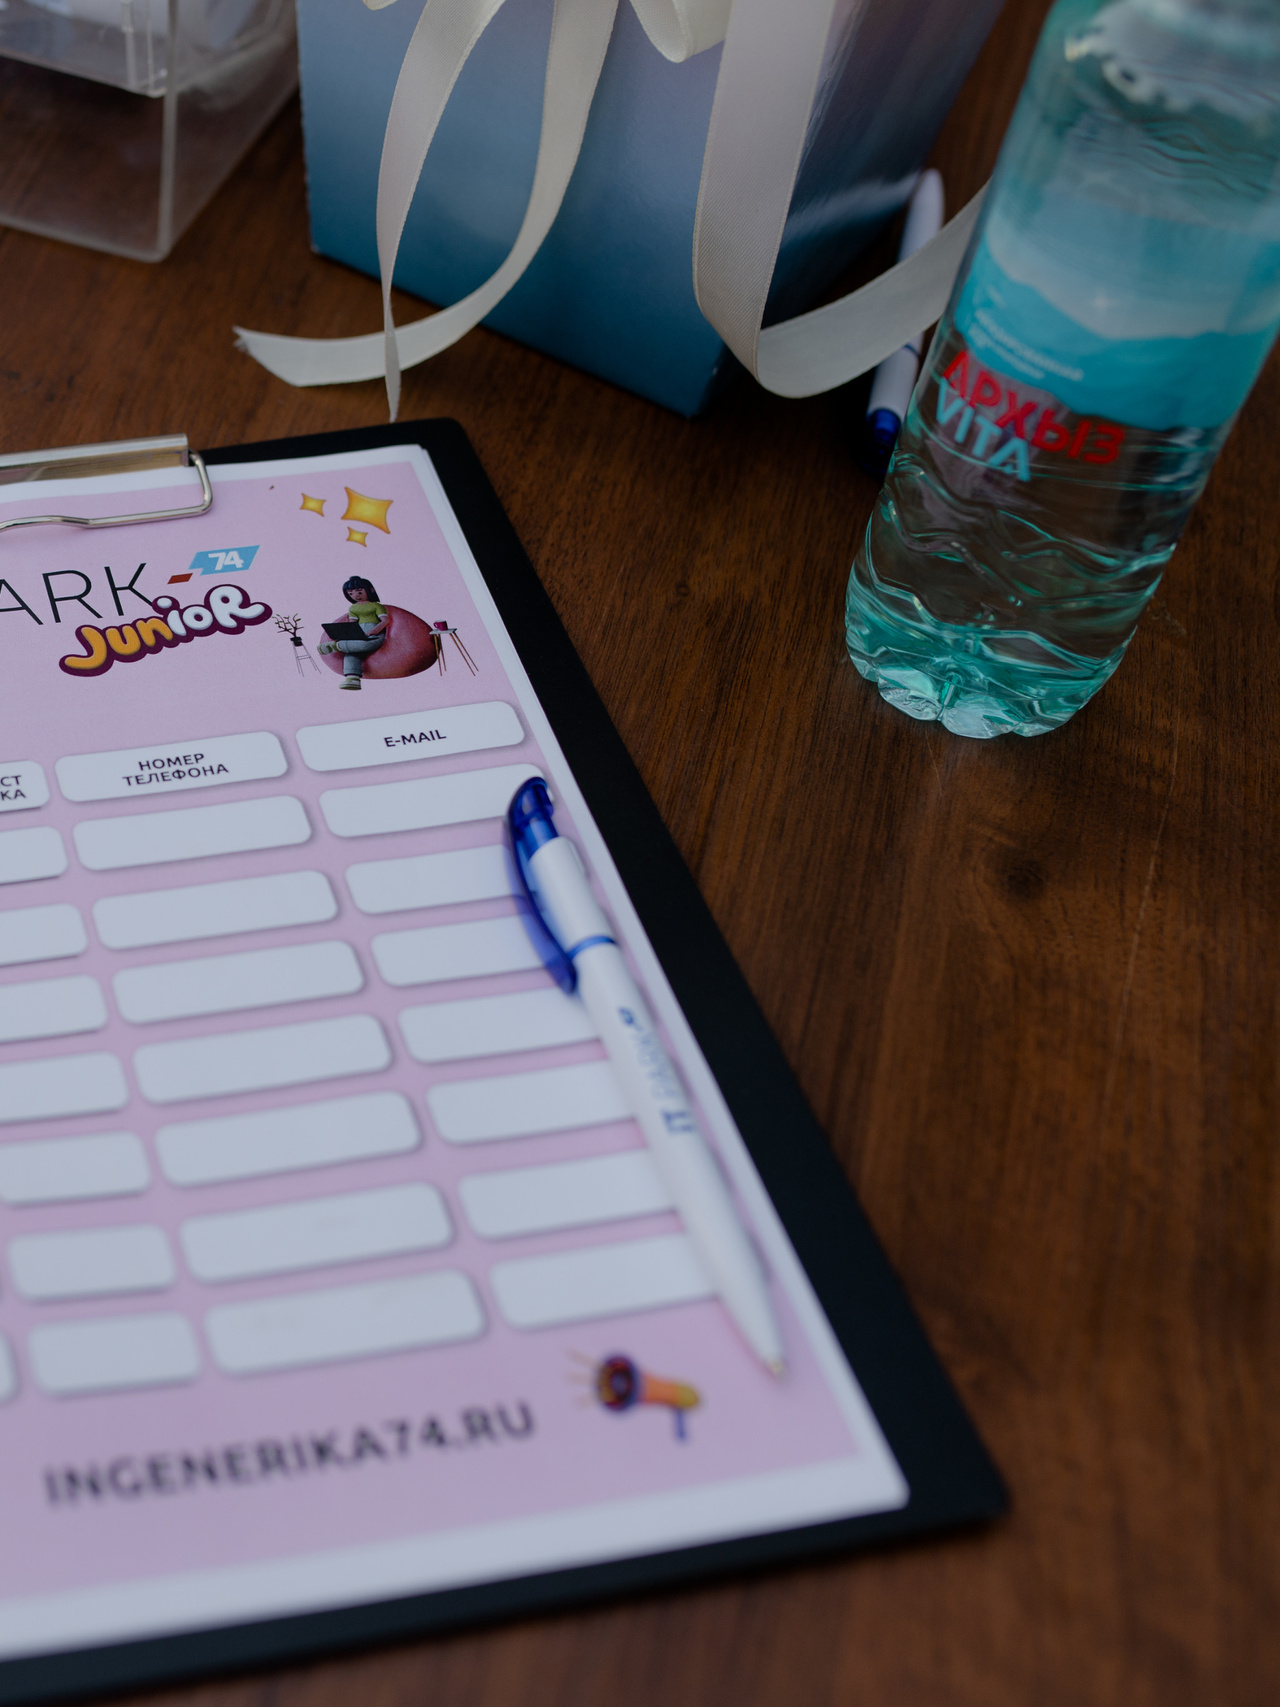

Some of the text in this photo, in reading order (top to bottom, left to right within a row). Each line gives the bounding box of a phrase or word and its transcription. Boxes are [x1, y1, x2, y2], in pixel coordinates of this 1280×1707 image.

[941, 349, 1126, 465] АРХЫЗ
[934, 377, 1031, 483] VITA
[208, 550, 245, 571] 74
[383, 729, 447, 748] E-MAIL
[138, 752, 205, 771] НОМЕР
[122, 763, 229, 787] ТЕЛЕФОНА
[42, 1399, 538, 1509] INGENERIKA74.RU
